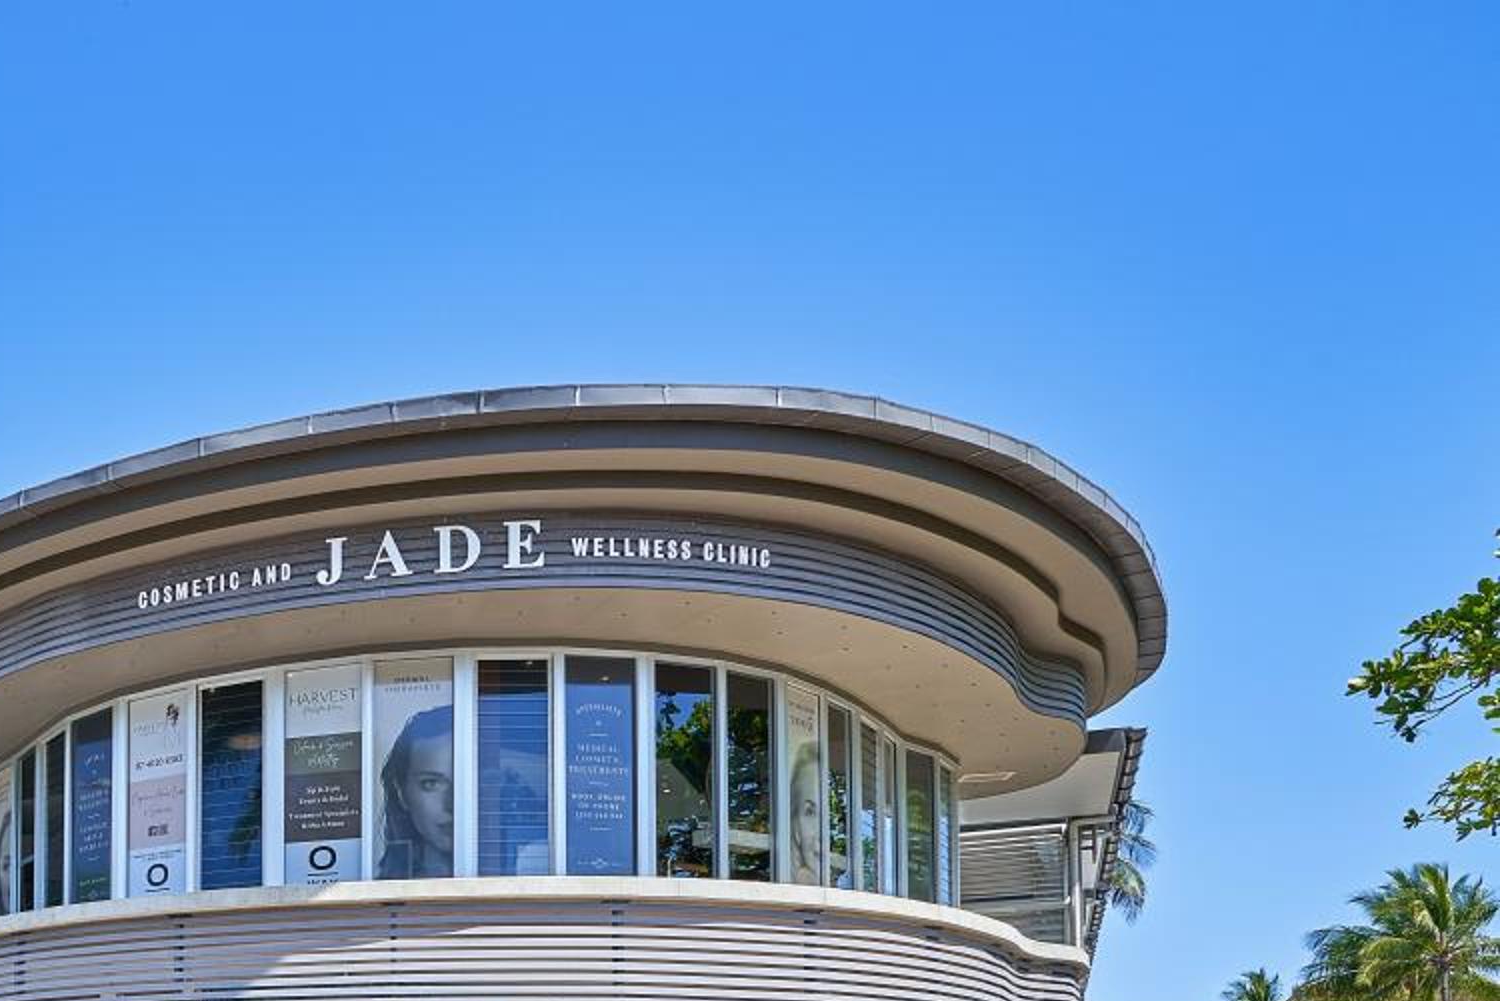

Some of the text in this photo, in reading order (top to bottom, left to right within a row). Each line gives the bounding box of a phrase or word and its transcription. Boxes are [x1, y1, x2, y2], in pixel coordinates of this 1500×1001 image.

[138, 519, 771, 609] COSMETIC AND JADE WELLNESS CLINIC
[289, 688, 357, 705] HARVEST
